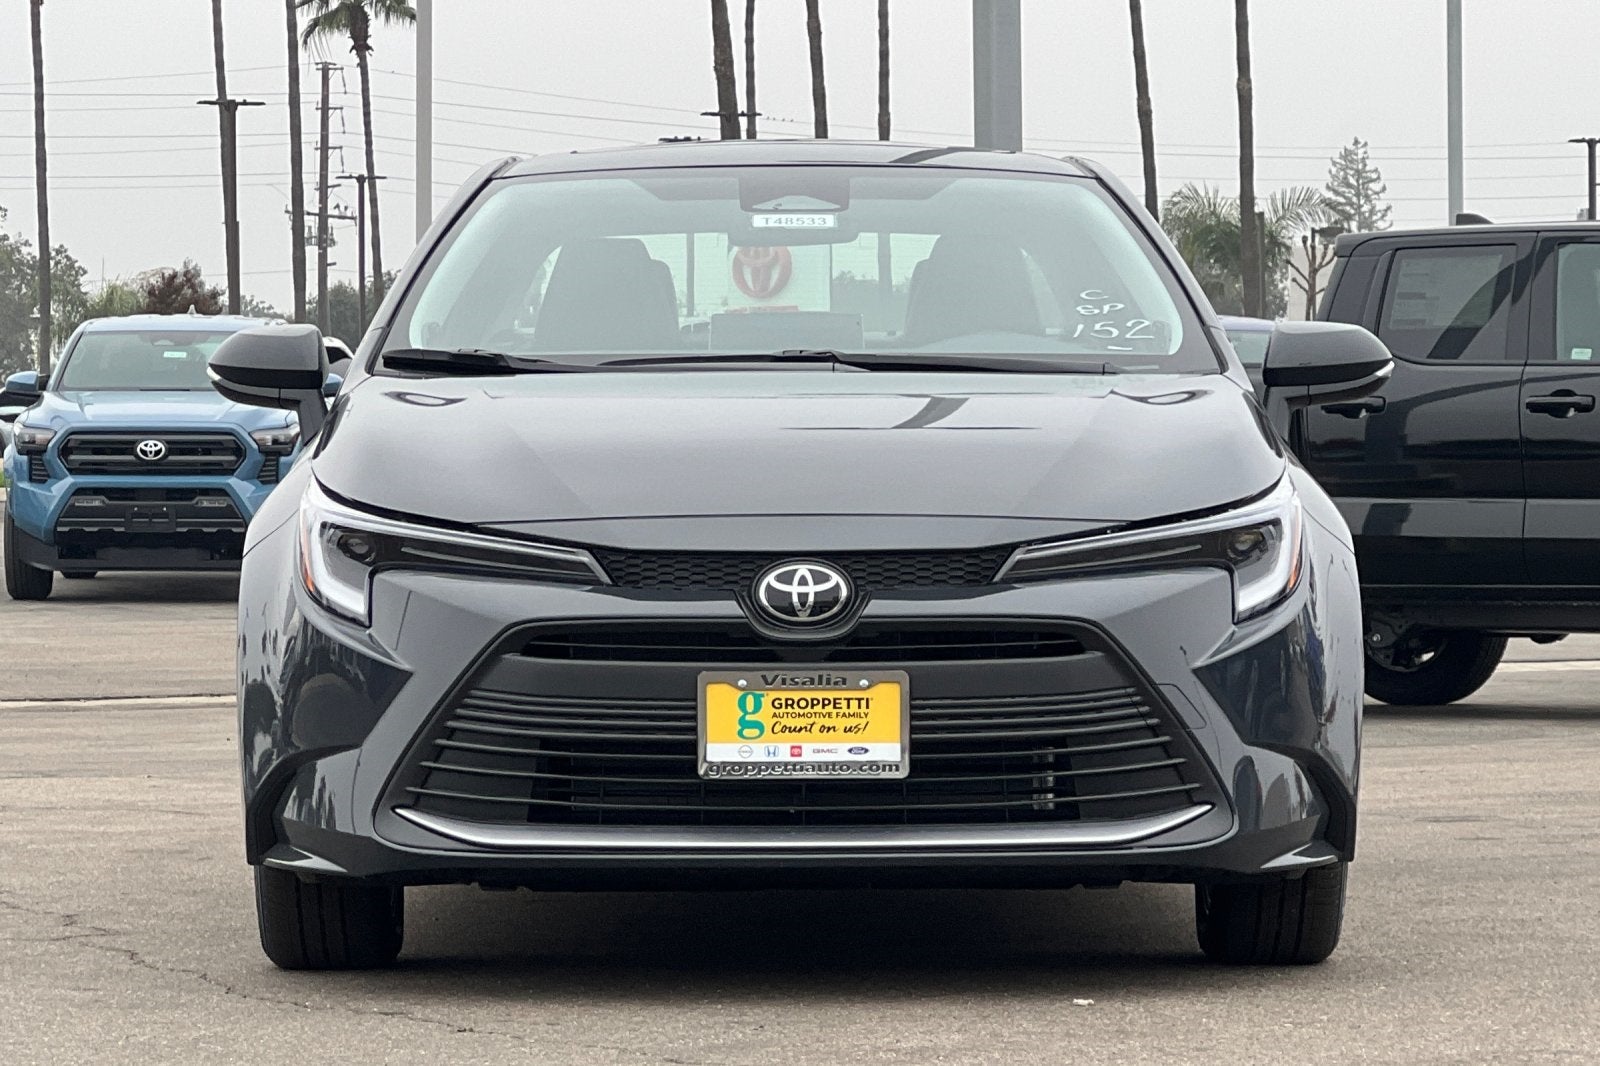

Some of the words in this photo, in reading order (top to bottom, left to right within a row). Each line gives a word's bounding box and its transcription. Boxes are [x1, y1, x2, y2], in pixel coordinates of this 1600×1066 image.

[761, 216, 827, 226] T48533
[1073, 319, 1155, 339] 152
[761, 673, 847, 688] Visalia
[771, 697, 870, 710] GROPPETTI
[737, 691, 765, 740] g
[771, 711, 833, 719] AUTOMOTIVE
[836, 711, 869, 719] FAMILY
[771, 720, 816, 735] Count
[818, 724, 838, 734] on
[843, 721, 869, 735] us!
[708, 762, 900, 778] groppettiauto.com
